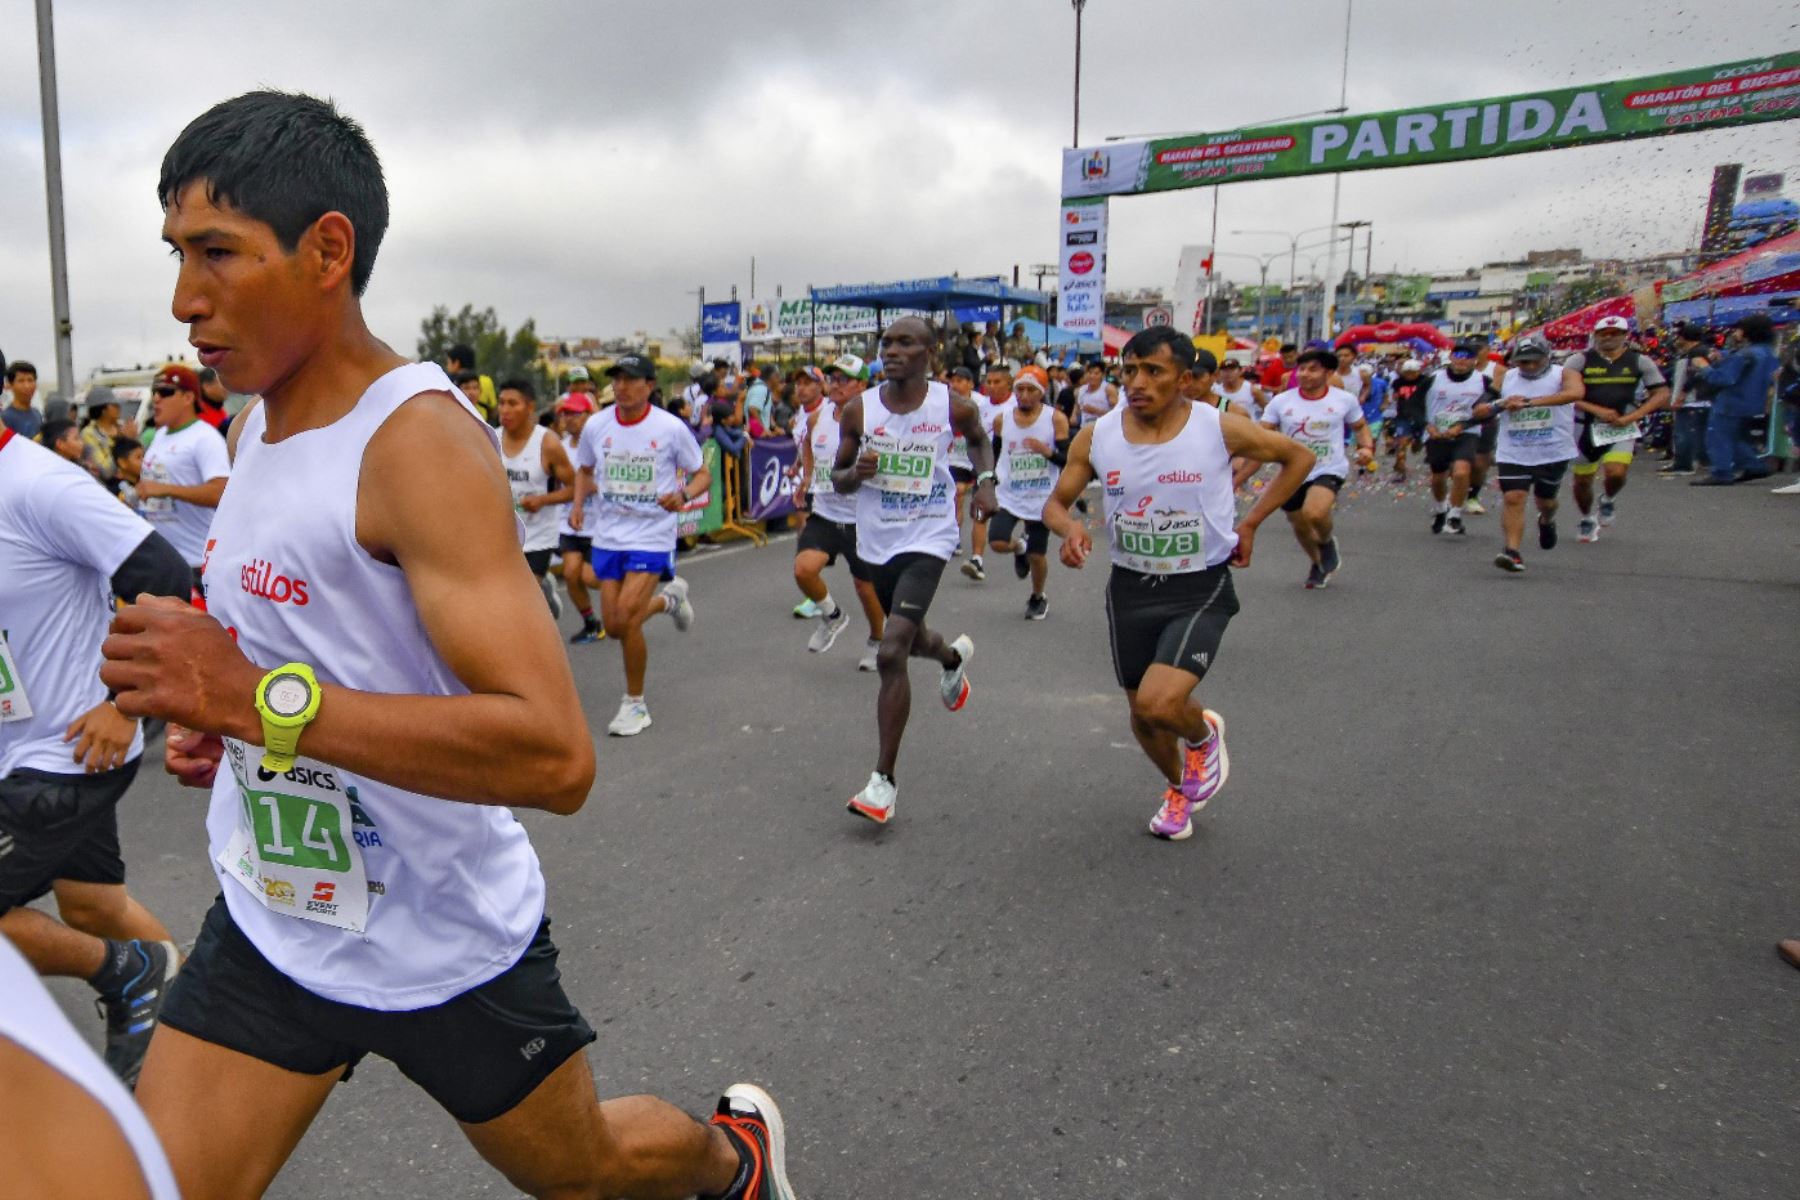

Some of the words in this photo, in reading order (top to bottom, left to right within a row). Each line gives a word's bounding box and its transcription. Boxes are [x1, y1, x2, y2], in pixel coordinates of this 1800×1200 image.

[1631, 86, 1703, 106] MARATÓN
[1707, 81, 1733, 94] DEL
[1665, 106, 1745, 126] CAYMA
[1309, 91, 1608, 164] PARTIDA
[1224, 138, 1291, 155] BICENTENARIO
[880, 454, 927, 476] 150
[1157, 470, 1202, 484] estilos
[1122, 532, 1193, 555] 0078
